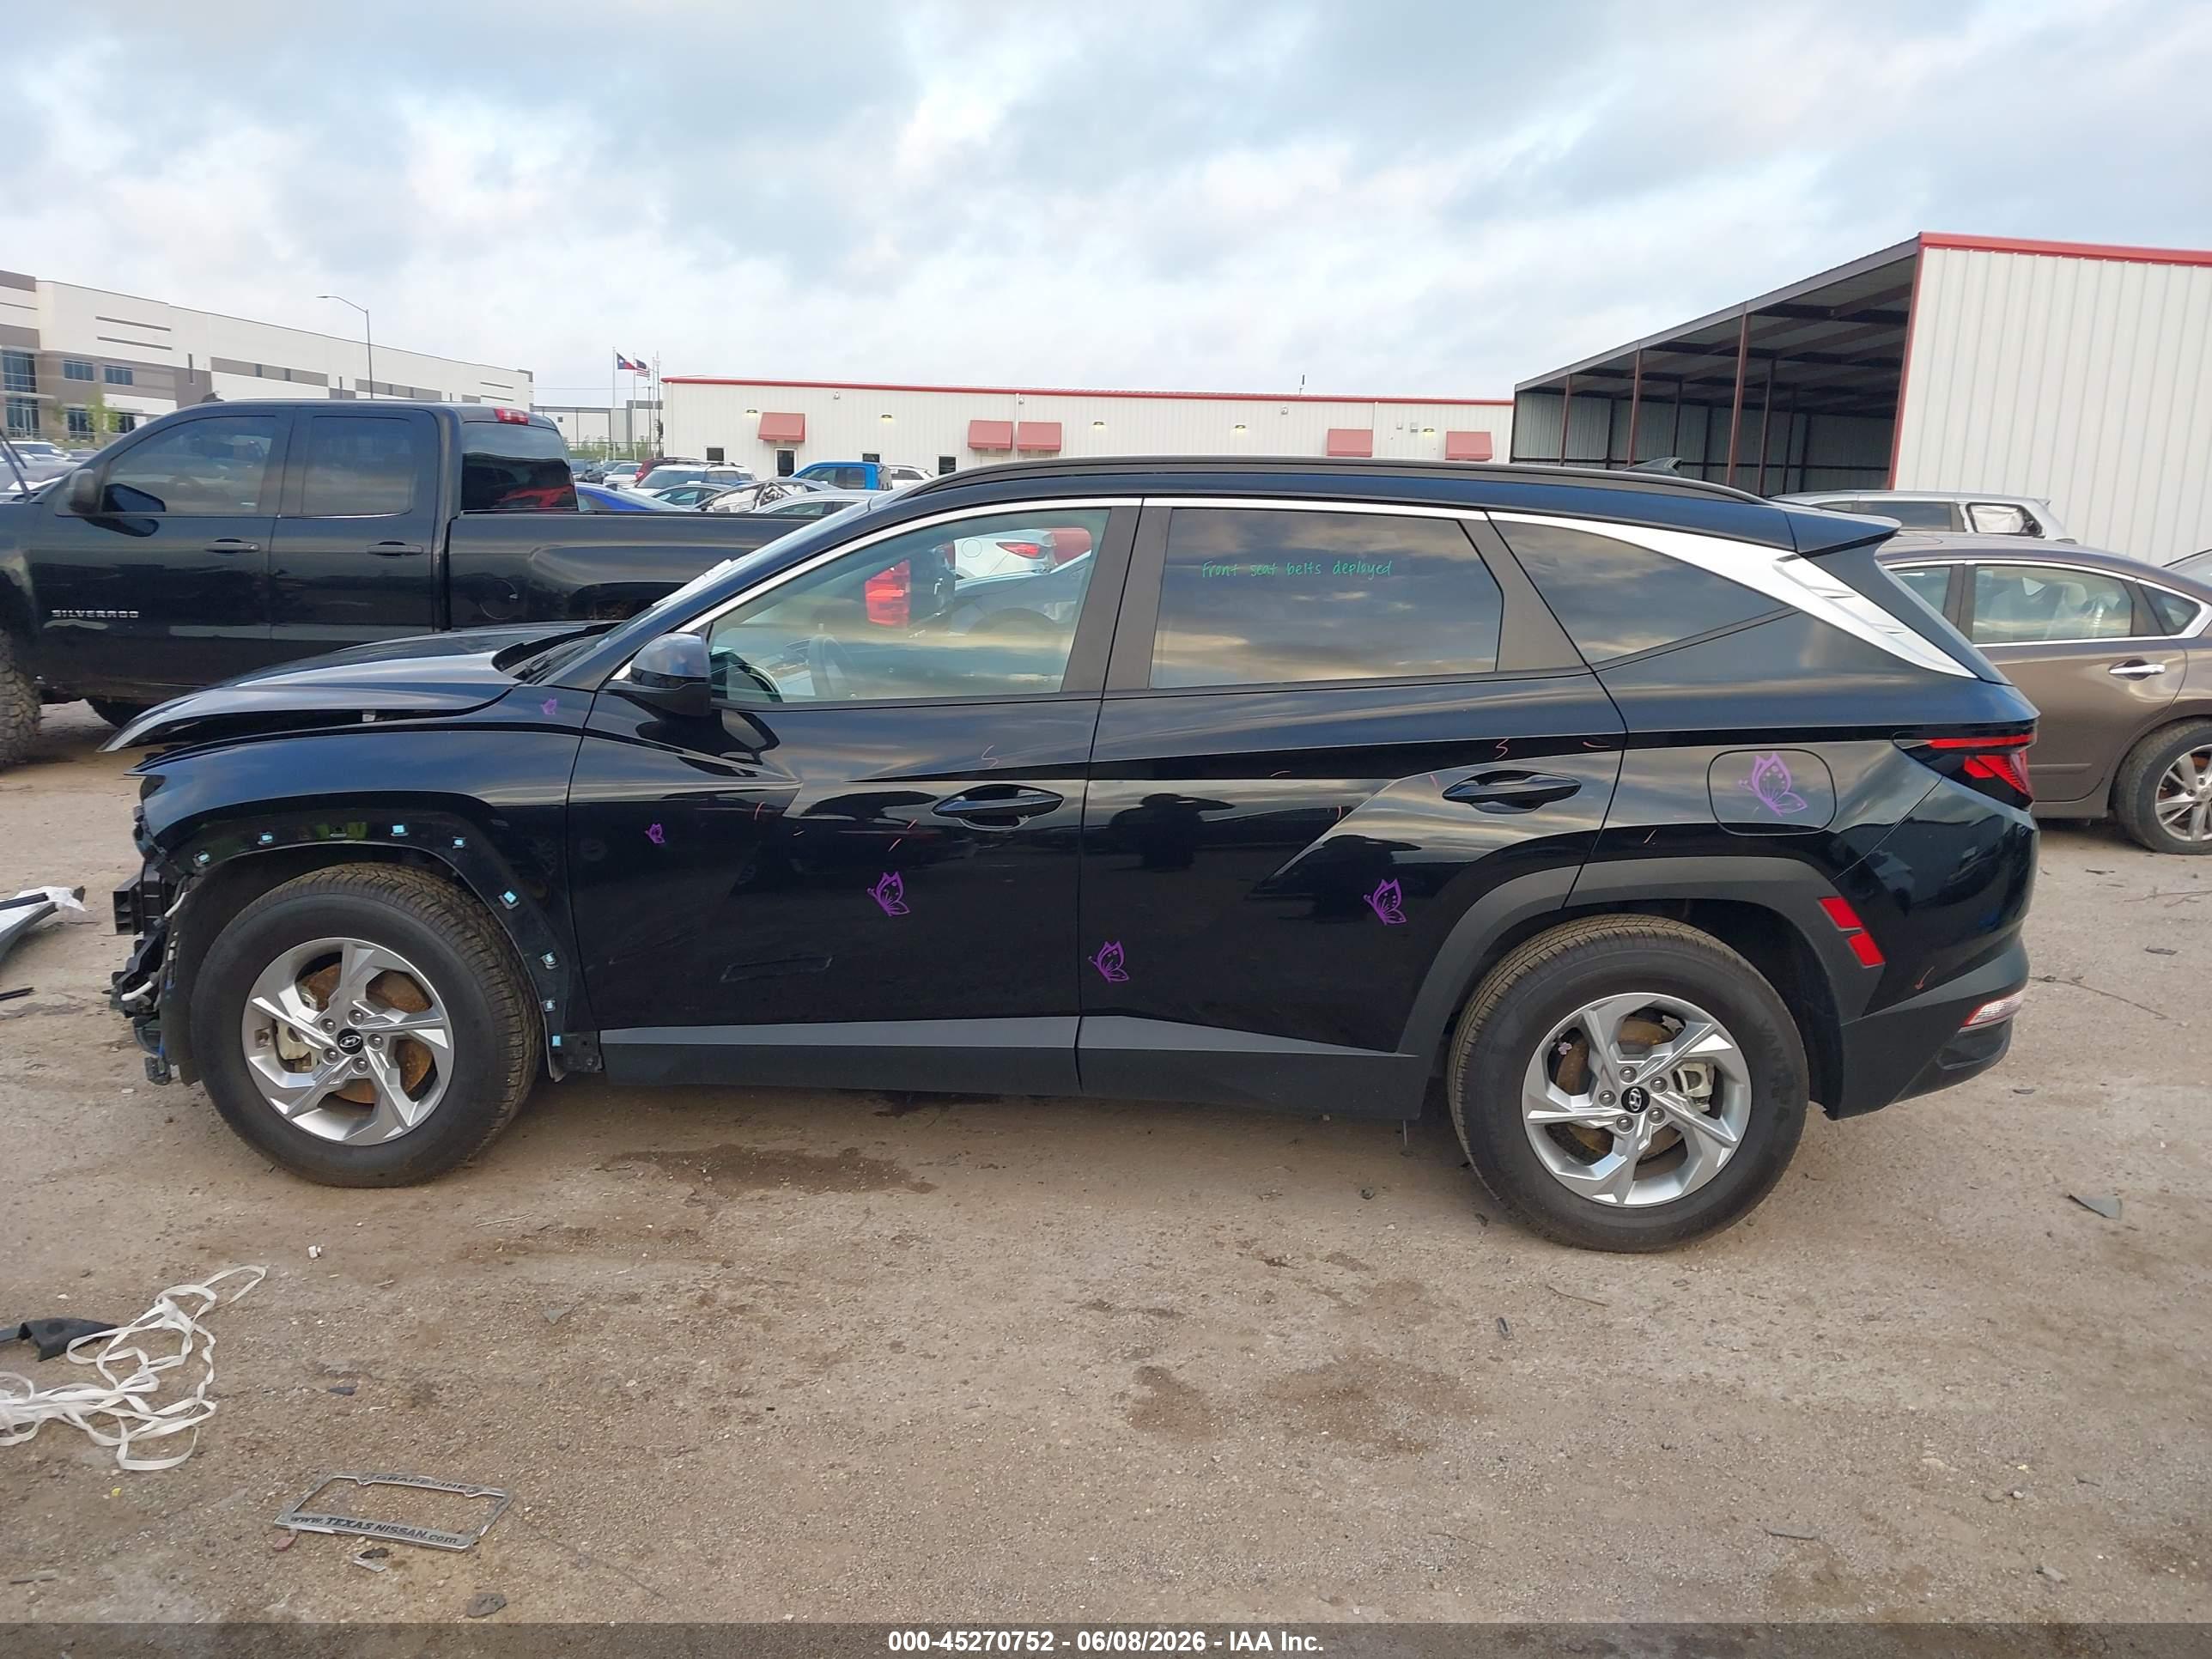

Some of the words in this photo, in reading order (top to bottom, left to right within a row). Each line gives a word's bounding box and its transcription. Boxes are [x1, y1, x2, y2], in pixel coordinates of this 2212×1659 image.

[1249, 562, 1279, 577] seat
[1286, 562, 1322, 576] belts
[1332, 560, 1393, 580] deployed
[51, 609, 139, 618] SILVERADO
[375, 1474, 470, 1491] GRAPEVINE
